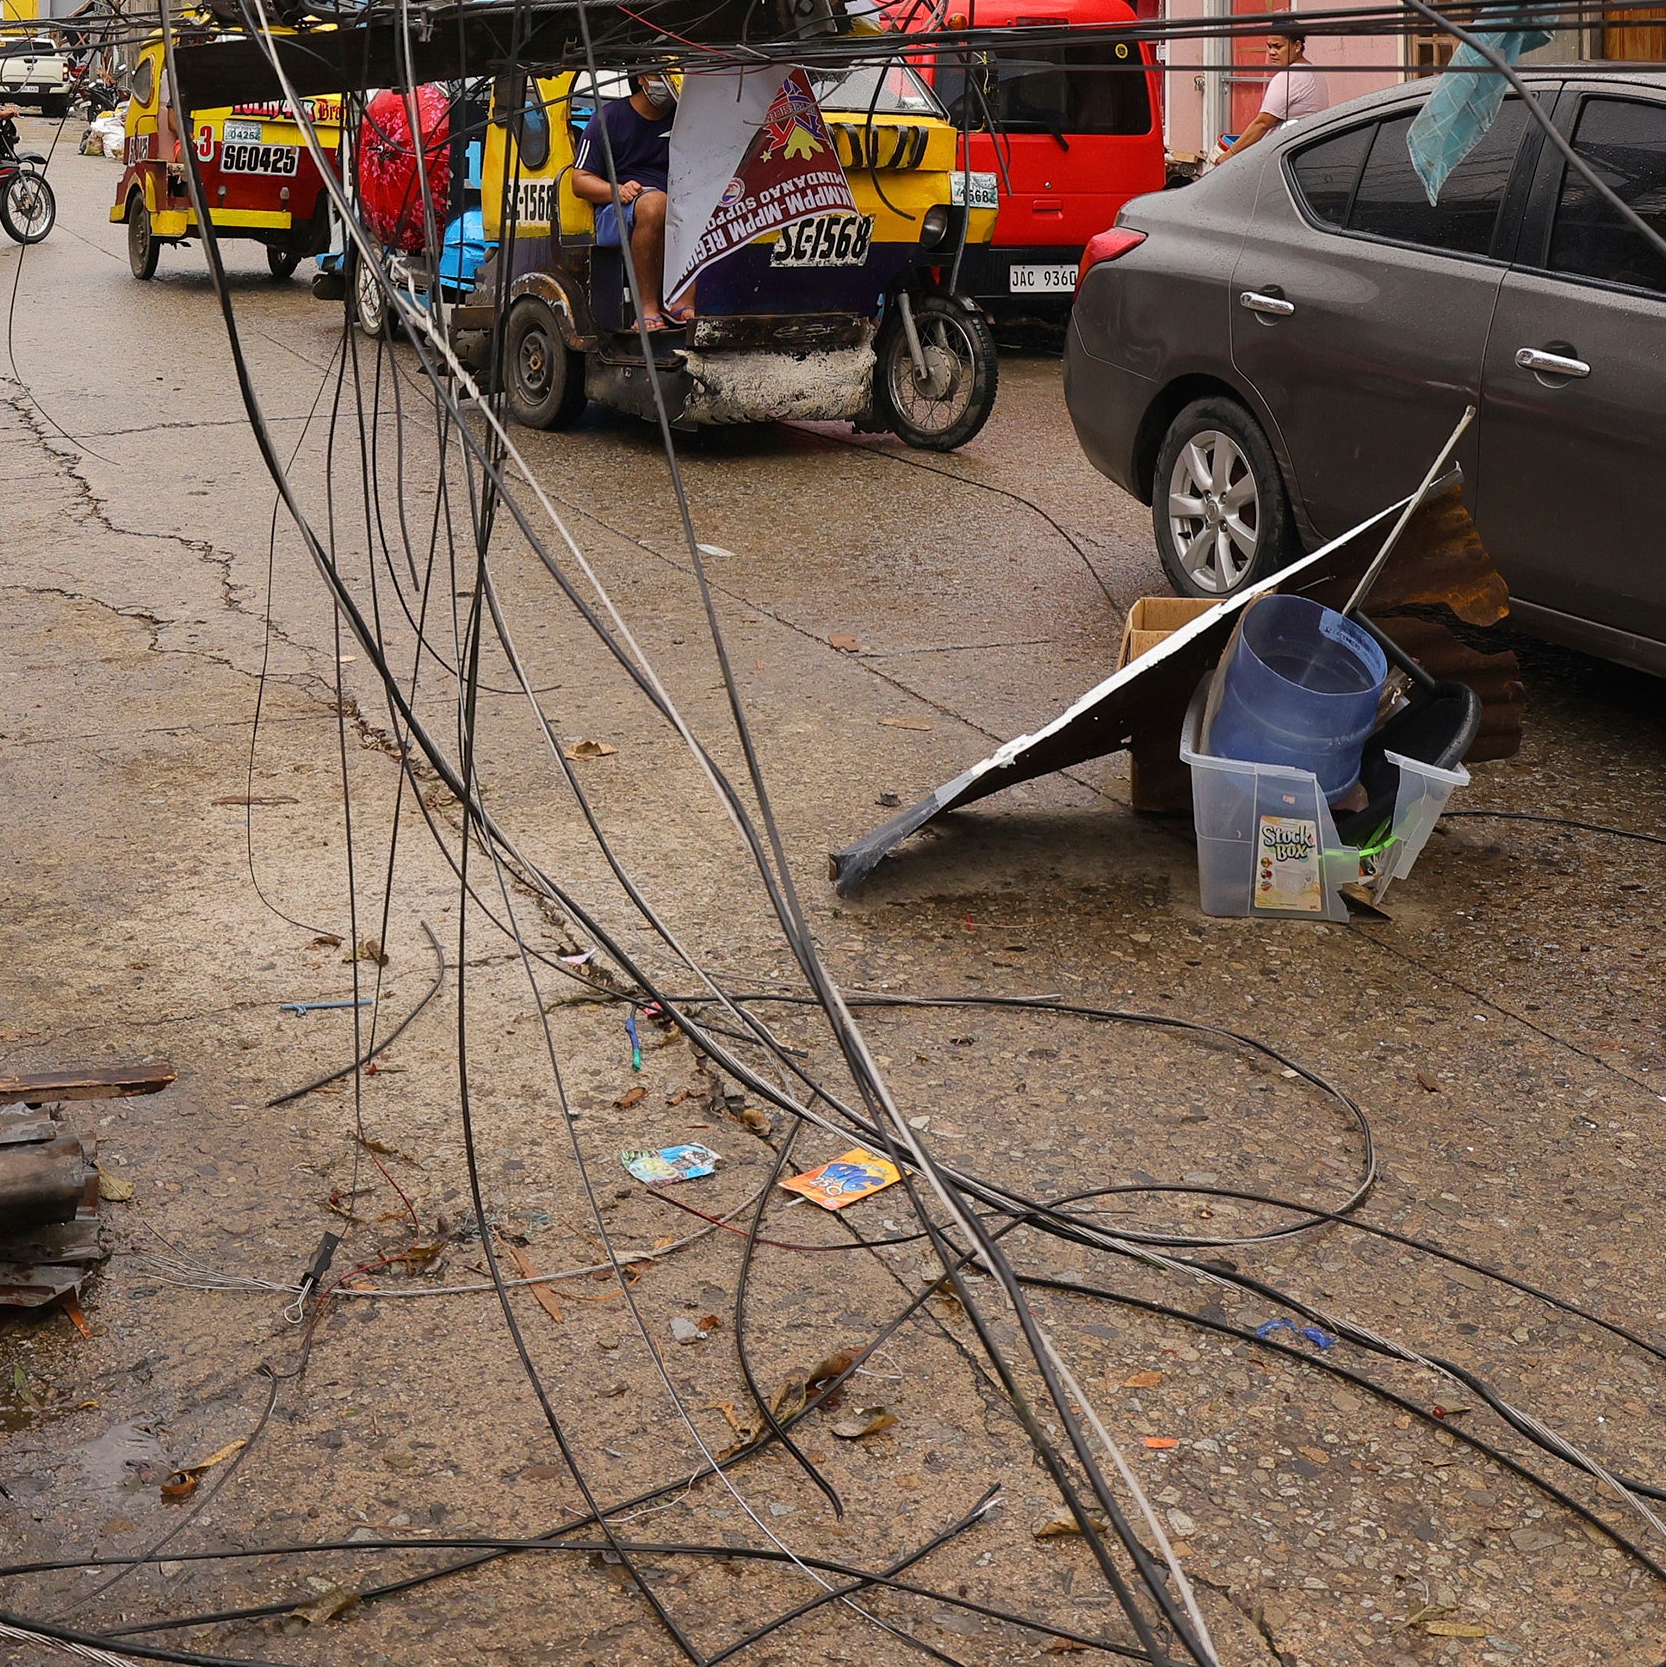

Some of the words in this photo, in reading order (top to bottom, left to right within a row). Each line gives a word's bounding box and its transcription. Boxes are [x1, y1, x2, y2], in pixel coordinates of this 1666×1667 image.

[198, 124, 213, 161] 3
[762, 171, 846, 203] MINDANAO
[1012, 270, 1035, 287] JAC
[1043, 270, 1077, 287] 9360
[1261, 825, 1315, 849] Stock
